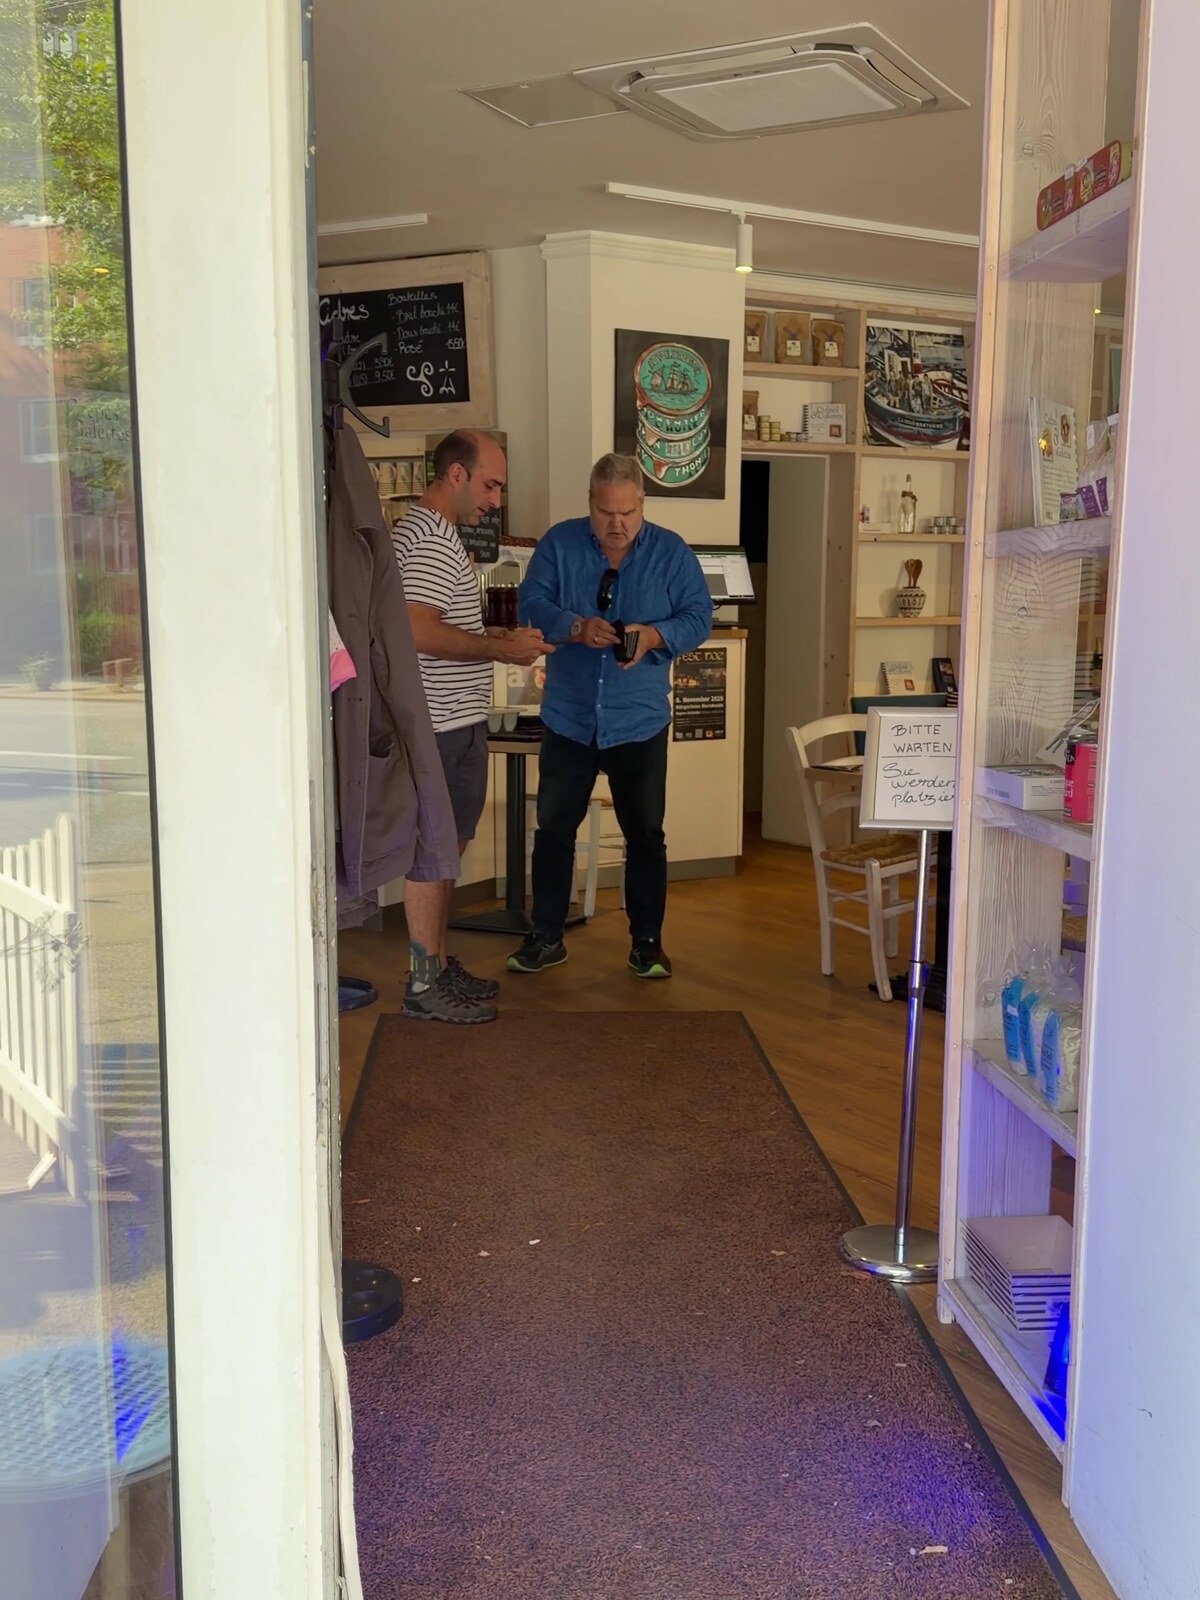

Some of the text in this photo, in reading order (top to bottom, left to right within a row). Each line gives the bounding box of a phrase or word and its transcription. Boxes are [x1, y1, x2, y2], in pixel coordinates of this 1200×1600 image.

[319, 298, 369, 326] Cidres
[398, 340, 424, 354] Rosé
[891, 724, 942, 737] BITTE
[894, 742, 953, 753] WARTEN
[882, 763, 921, 778] Sie
[891, 791, 955, 807] platzie
